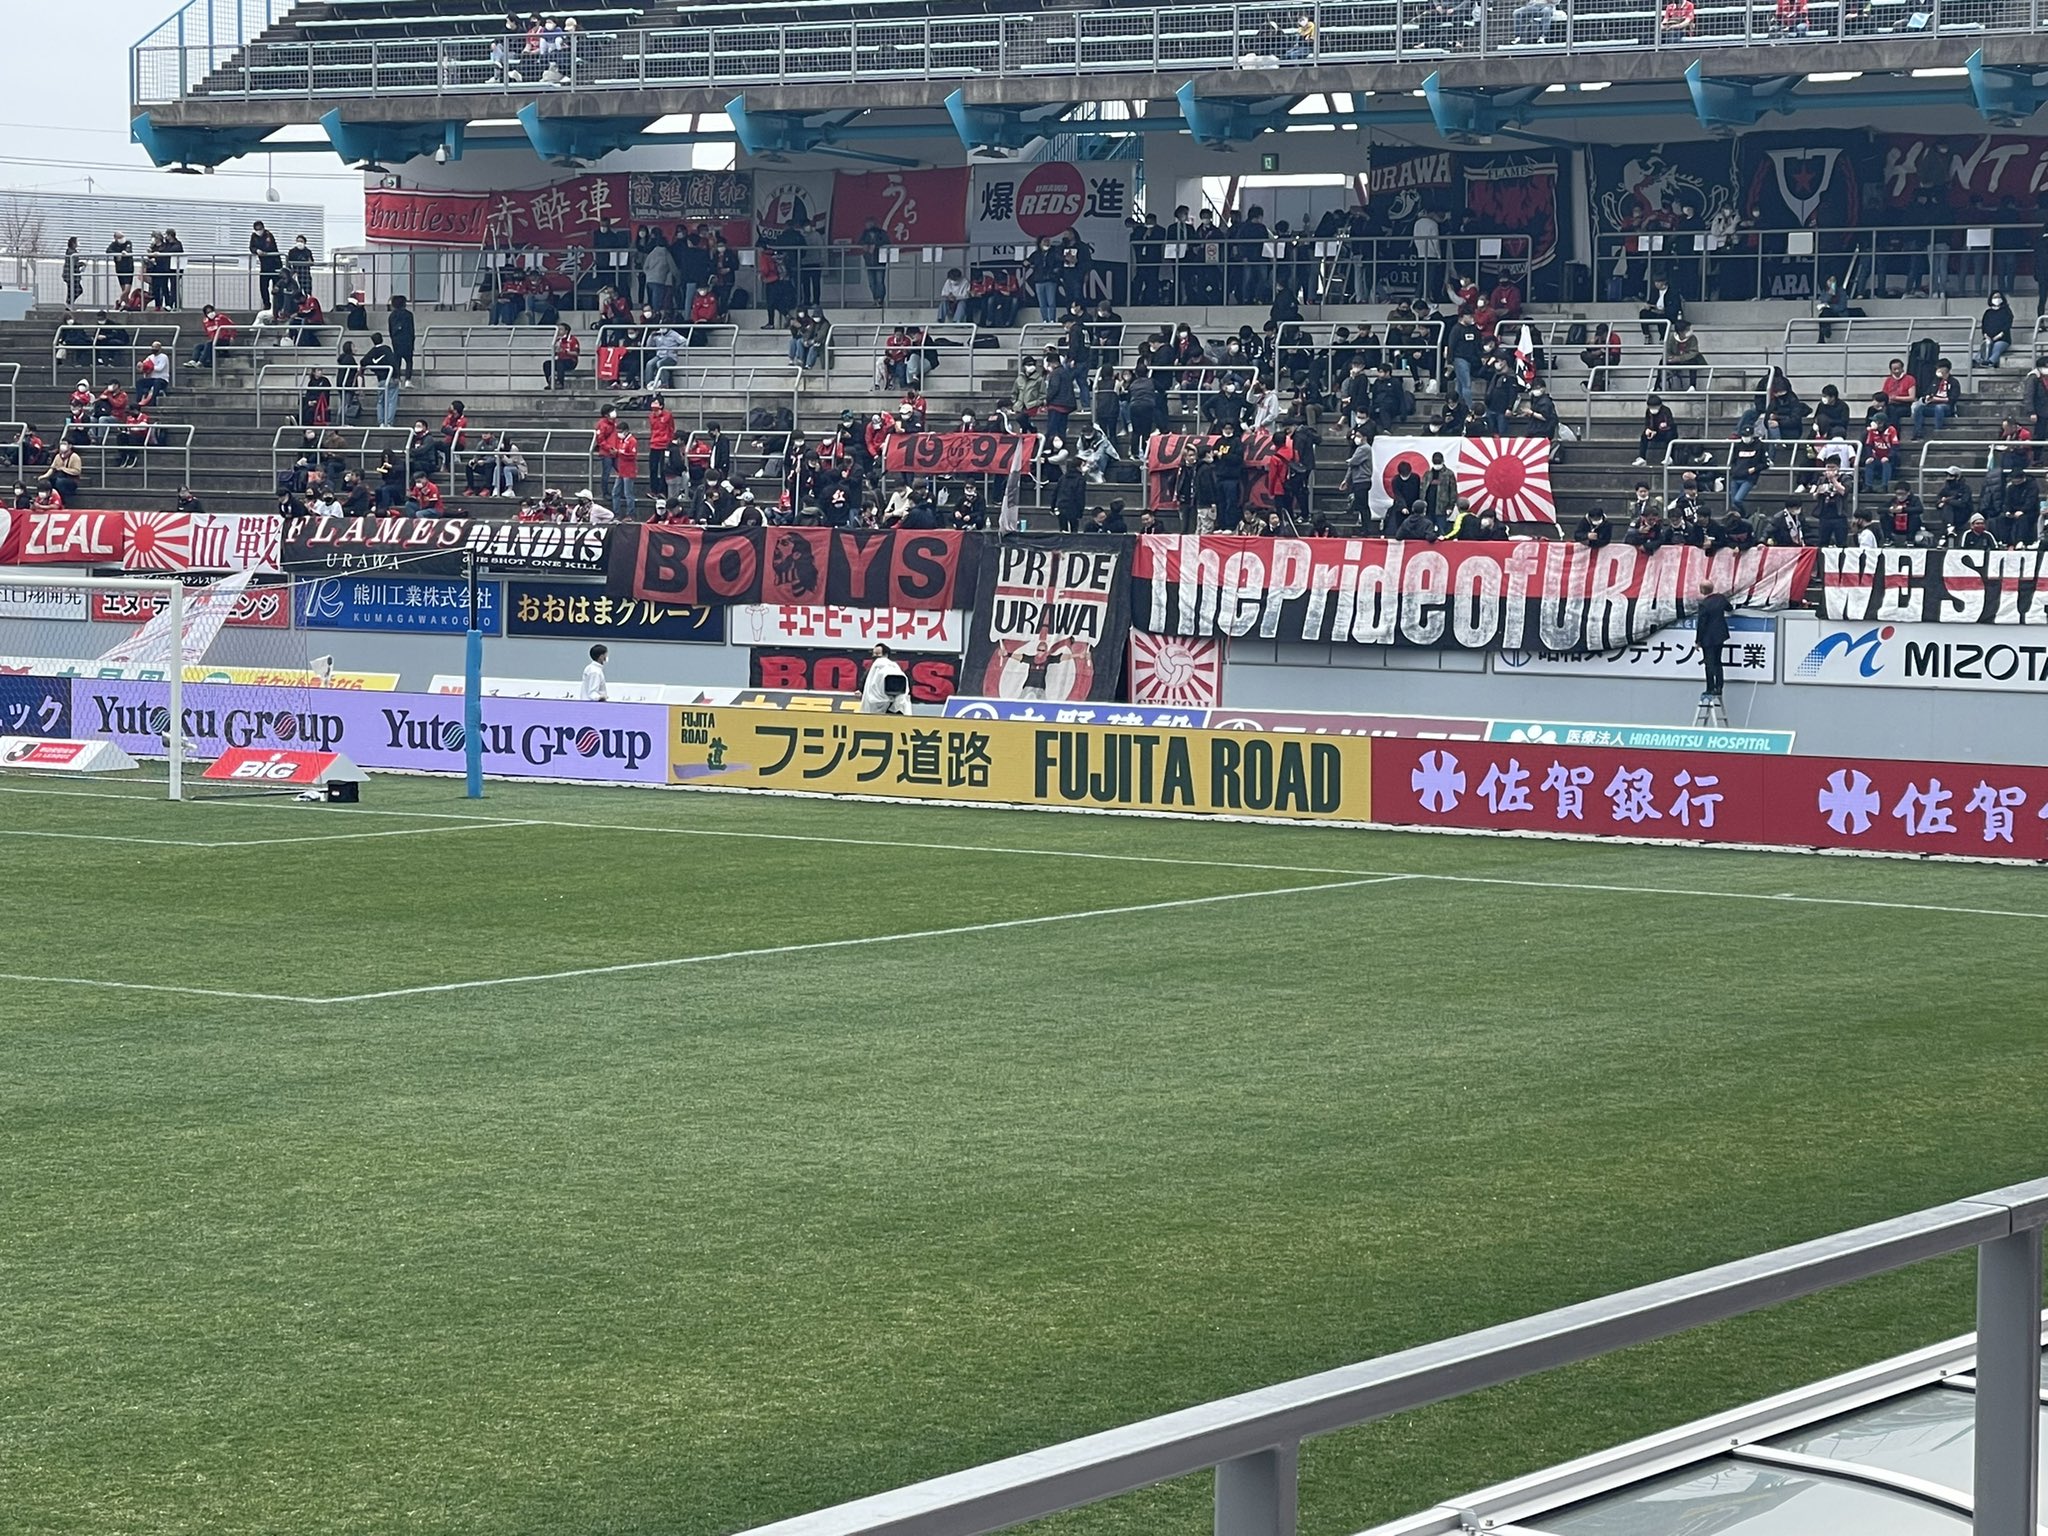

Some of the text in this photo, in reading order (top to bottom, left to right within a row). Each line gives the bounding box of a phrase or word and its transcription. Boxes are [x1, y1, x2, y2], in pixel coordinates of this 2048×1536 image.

[1372, 152, 1451, 191] URAWA
[1487, 165, 1535, 179] FLAMES
[1883, 134, 2030, 198] HNT
[980, 182, 1014, 221] 爆
[1019, 194, 1081, 216] REDS
[1036, 184, 1068, 193] URAWA
[1084, 178, 1124, 218] 進
[25, 514, 114, 555] ZEAL
[285, 516, 468, 547] FLAMES
[465, 524, 608, 562] DANDYS
[326, 553, 400, 570] URAWA
[491, 556, 526, 566] SHOT
[532, 559, 562, 567] ONE
[565, 561, 602, 571] KILL
[642, 530, 948, 600] BOYS
[1002, 547, 1112, 590] PRIDE
[353, 583, 492, 610] 熊川工業株式会社
[1821, 548, 1927, 623] WE
[353, 612, 491, 627] KUMAGAWAKOGO
[994, 599, 1098, 639] URAWA
[1904, 641, 2048, 681] MIZOT
[0, 695, 64, 734] ック
[223, 709, 345, 752] Group
[681, 711, 716, 729] FUJITA
[522, 724, 652, 769] Group
[681, 729, 709, 744] ROAD
[1566, 730, 1626, 746] 医療法人
[1629, 733, 1772, 751] HIRAMATSU HOSPITAL
[230, 758, 300, 779] BIG
[755, 724, 992, 789] フジタ道路
[1034, 730, 1341, 813] FUJITA ROAD
[1476, 757, 1724, 829] 佐賀銀行
[1891, 777, 2048, 843] 佐賀
